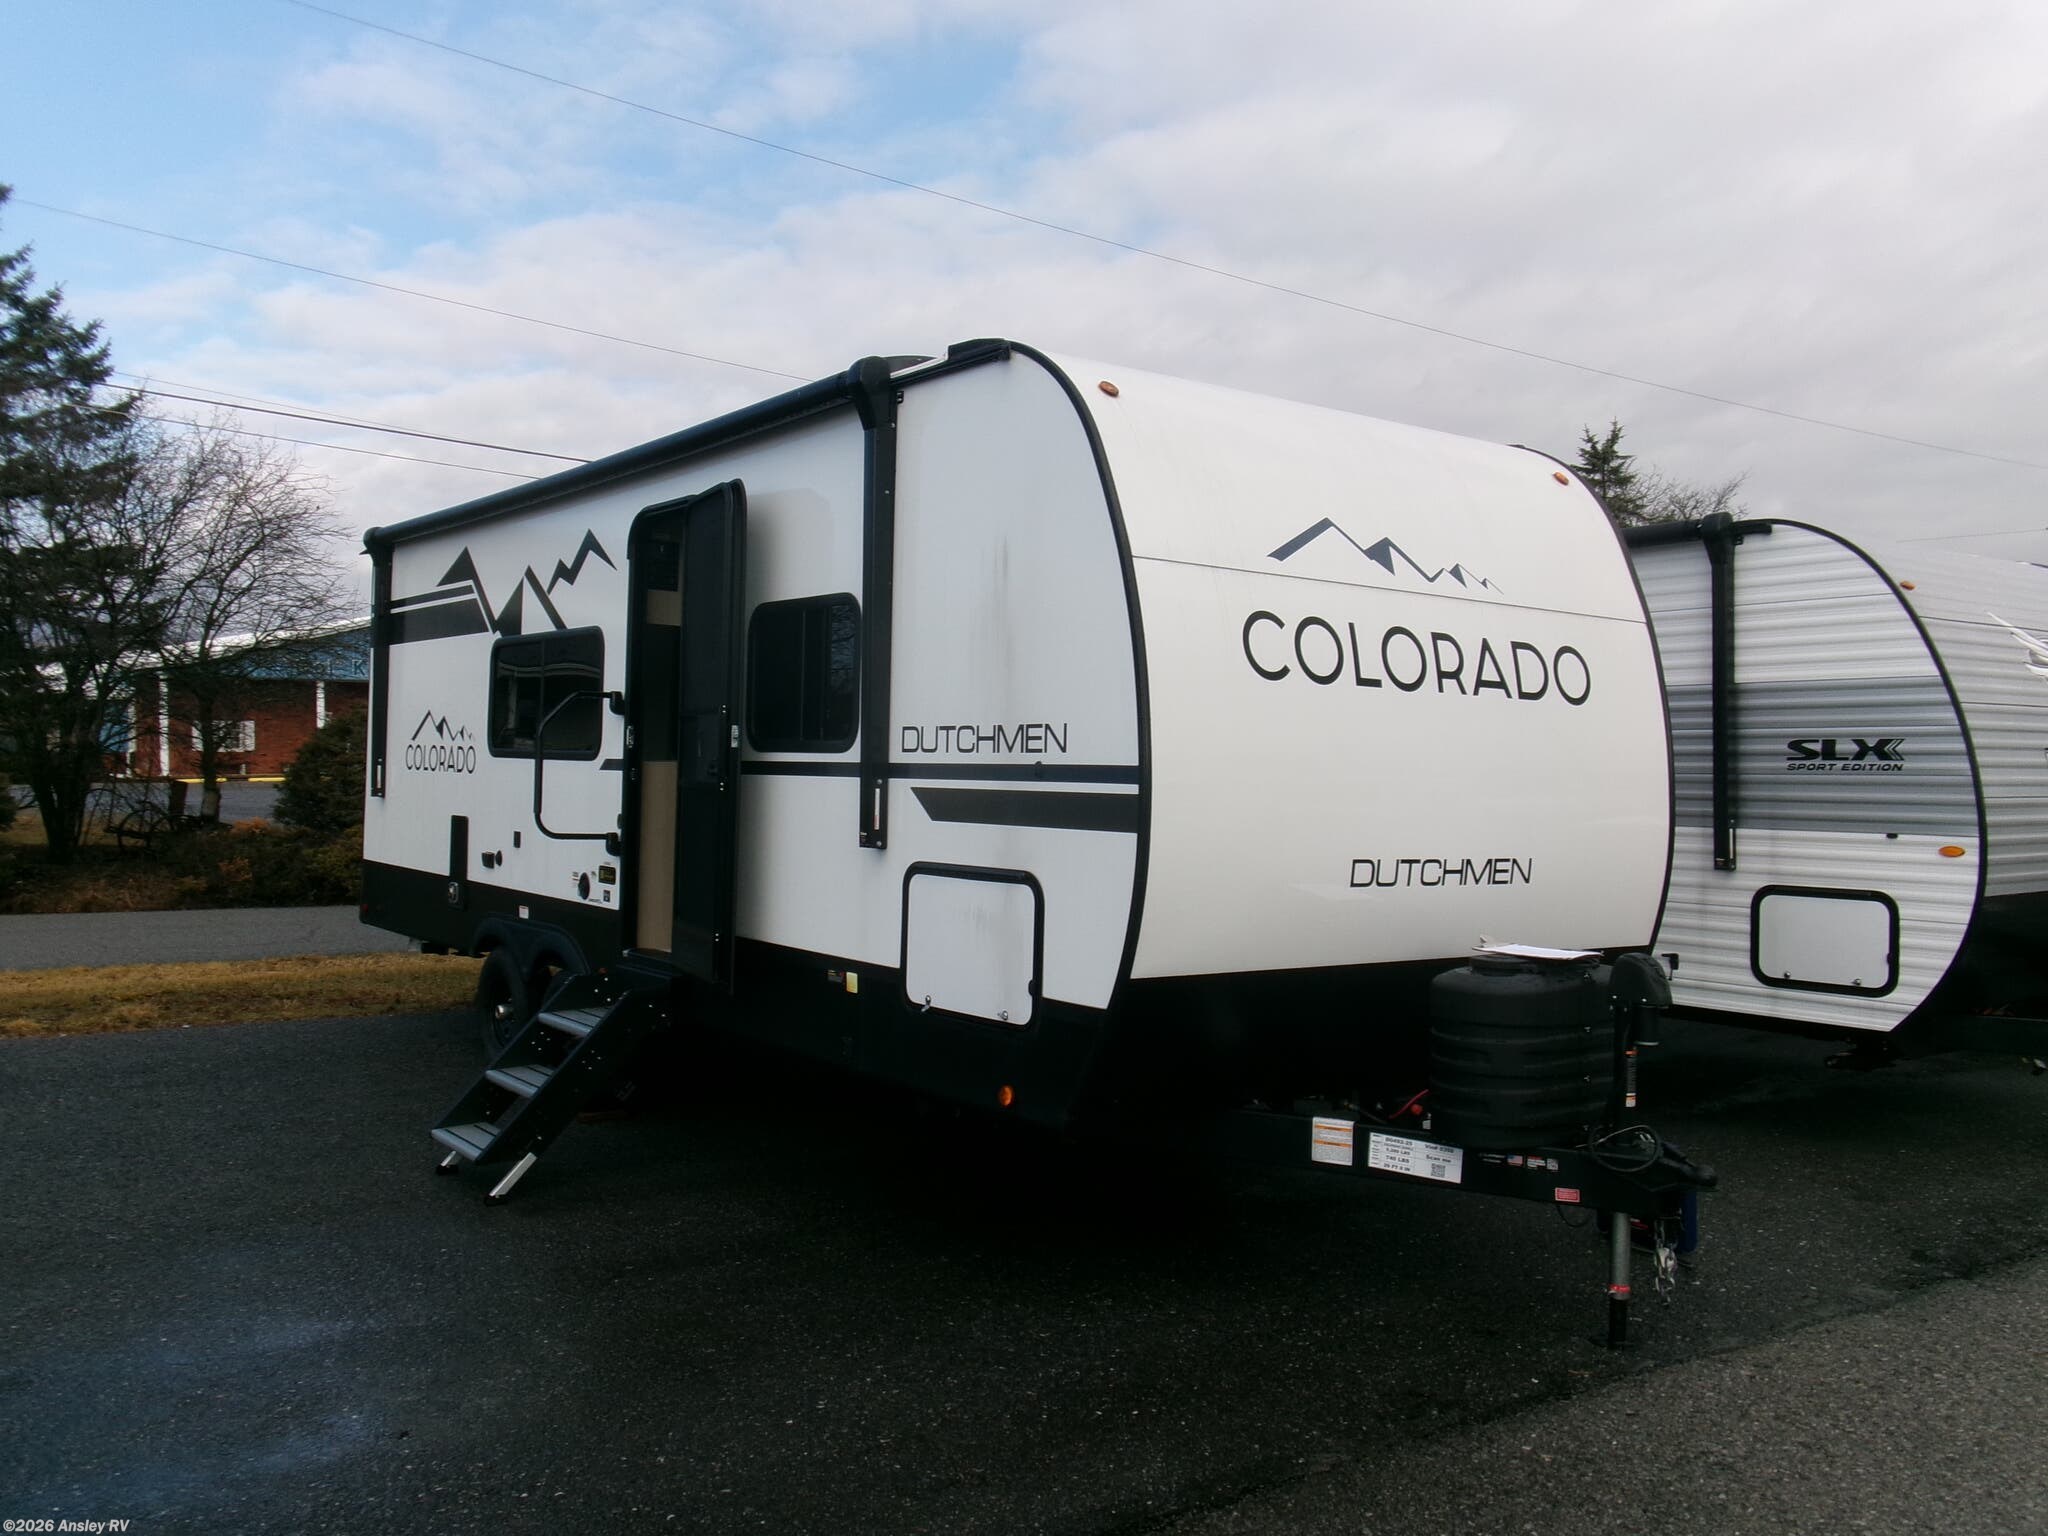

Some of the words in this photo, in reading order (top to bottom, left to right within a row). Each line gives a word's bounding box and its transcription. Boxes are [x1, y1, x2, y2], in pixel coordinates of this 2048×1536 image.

[1242, 610, 1591, 706] COLORADO
[901, 723, 1068, 754] DUTCHMEN
[1786, 738, 1905, 761] SLX
[405, 743, 476, 775] COLORADO
[1787, 763, 1837, 771] SPORT
[1841, 763, 1904, 771] EDITION
[1350, 858, 1532, 888] DUTCHMEN
[1425, 1154, 1440, 1162] Scan
